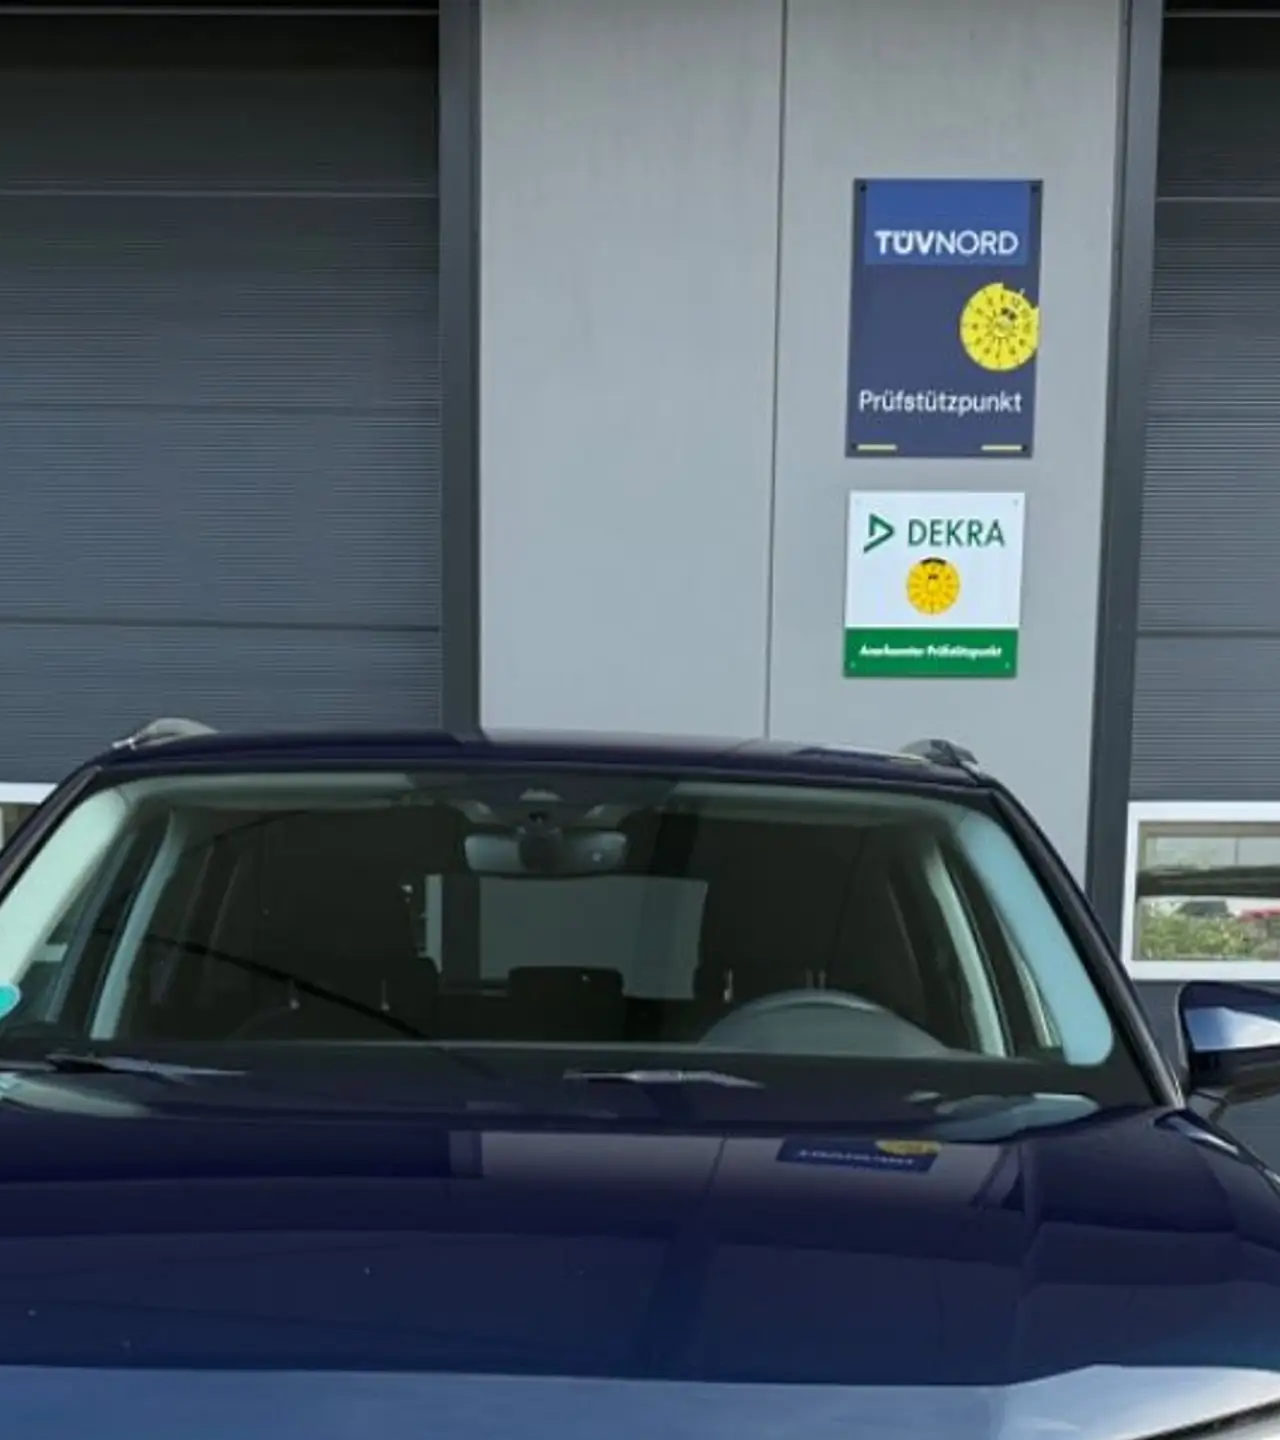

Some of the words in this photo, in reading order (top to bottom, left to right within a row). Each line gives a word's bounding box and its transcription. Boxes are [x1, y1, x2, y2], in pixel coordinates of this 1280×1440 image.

[874, 230, 1019, 255] TÜVNORD
[859, 389, 1022, 416] Prüfstützpunkt
[907, 518, 1006, 547] DEKRA
